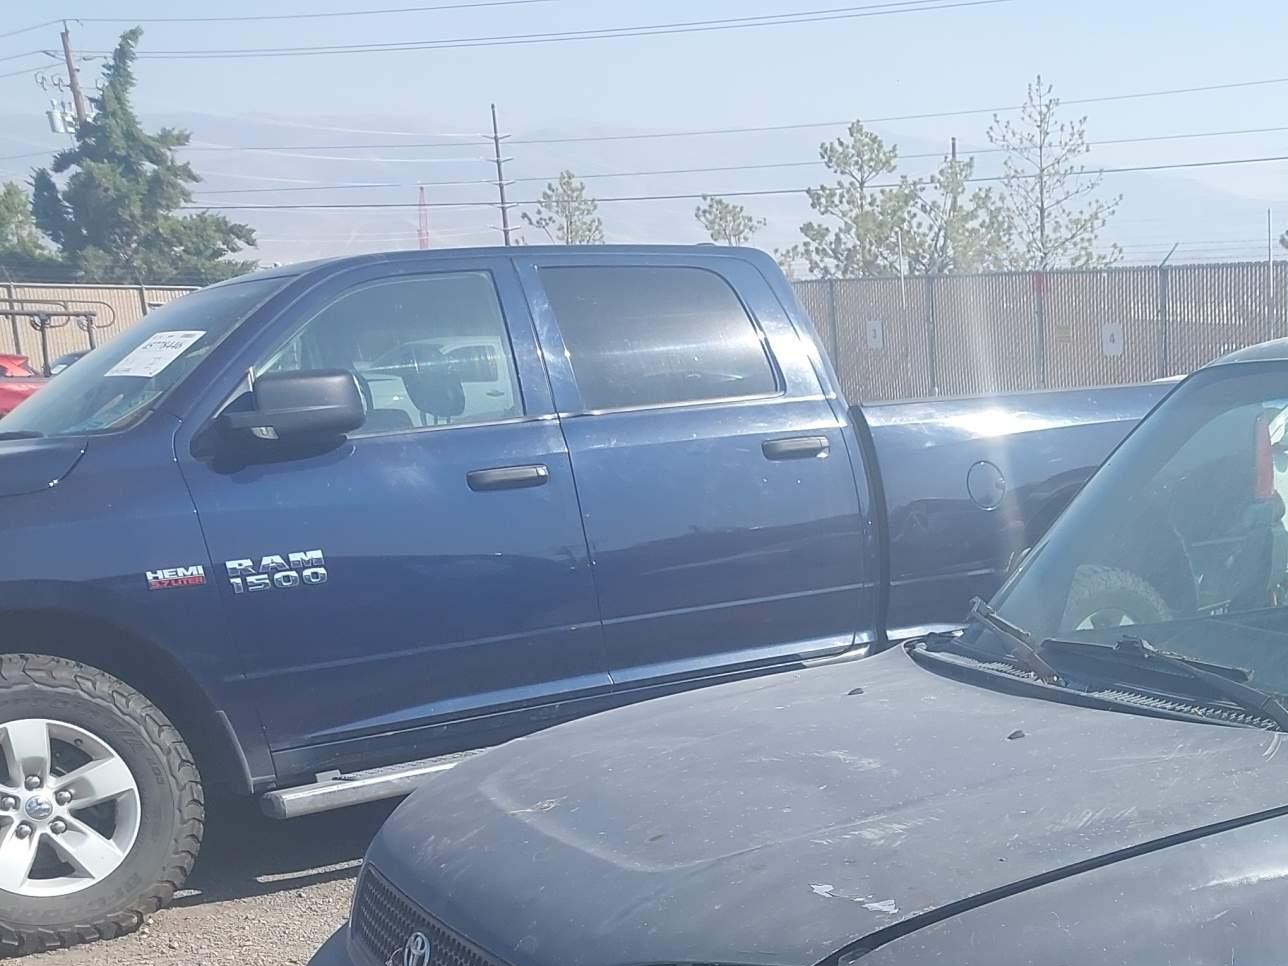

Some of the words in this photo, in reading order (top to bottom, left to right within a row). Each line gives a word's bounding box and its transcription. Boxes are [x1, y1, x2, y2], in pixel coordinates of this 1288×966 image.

[145, 565, 204, 580] HEMI
[225, 549, 324, 577] RAM
[229, 567, 328, 594] 1500
